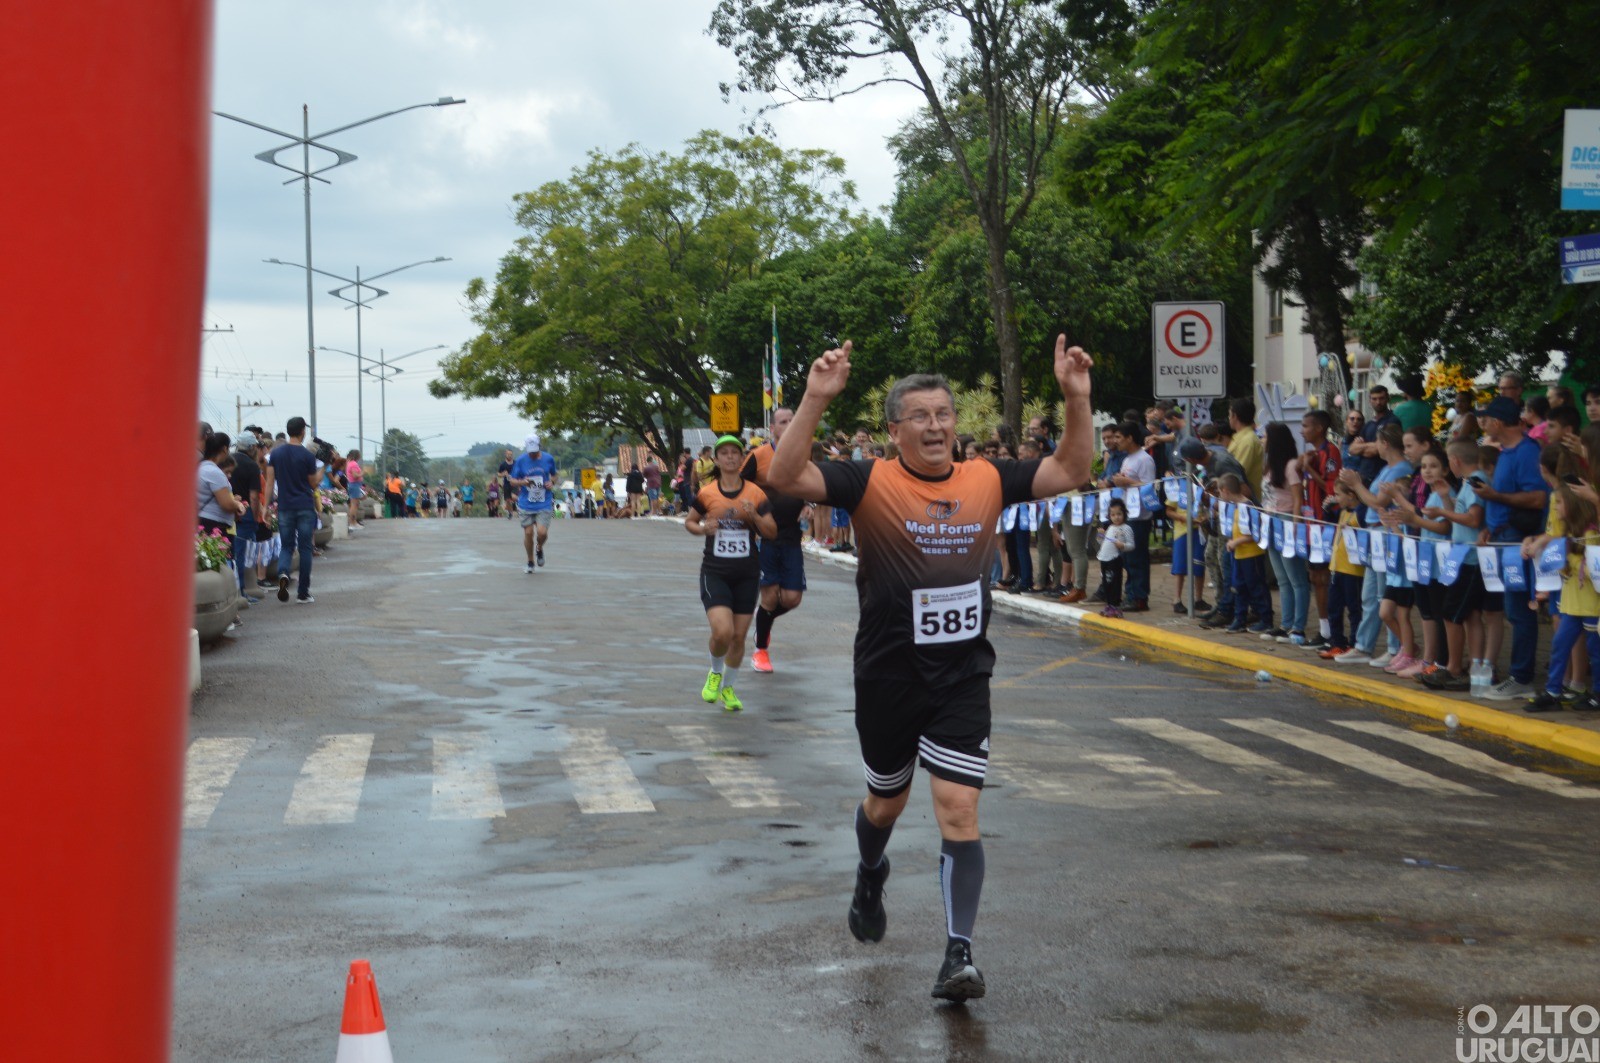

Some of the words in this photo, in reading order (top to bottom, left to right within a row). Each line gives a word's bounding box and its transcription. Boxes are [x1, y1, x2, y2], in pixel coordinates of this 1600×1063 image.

[1571, 146, 1600, 162] DIG
[1180, 321, 1196, 347] E
[1160, 365, 1218, 376] EXCLUSIVO
[1178, 376, 1202, 388] TÁXI
[905, 520, 936, 534] Med
[940, 523, 982, 534] Forma
[718, 540, 748, 553] 553
[914, 536, 974, 545] Academia
[920, 604, 978, 636] 585
